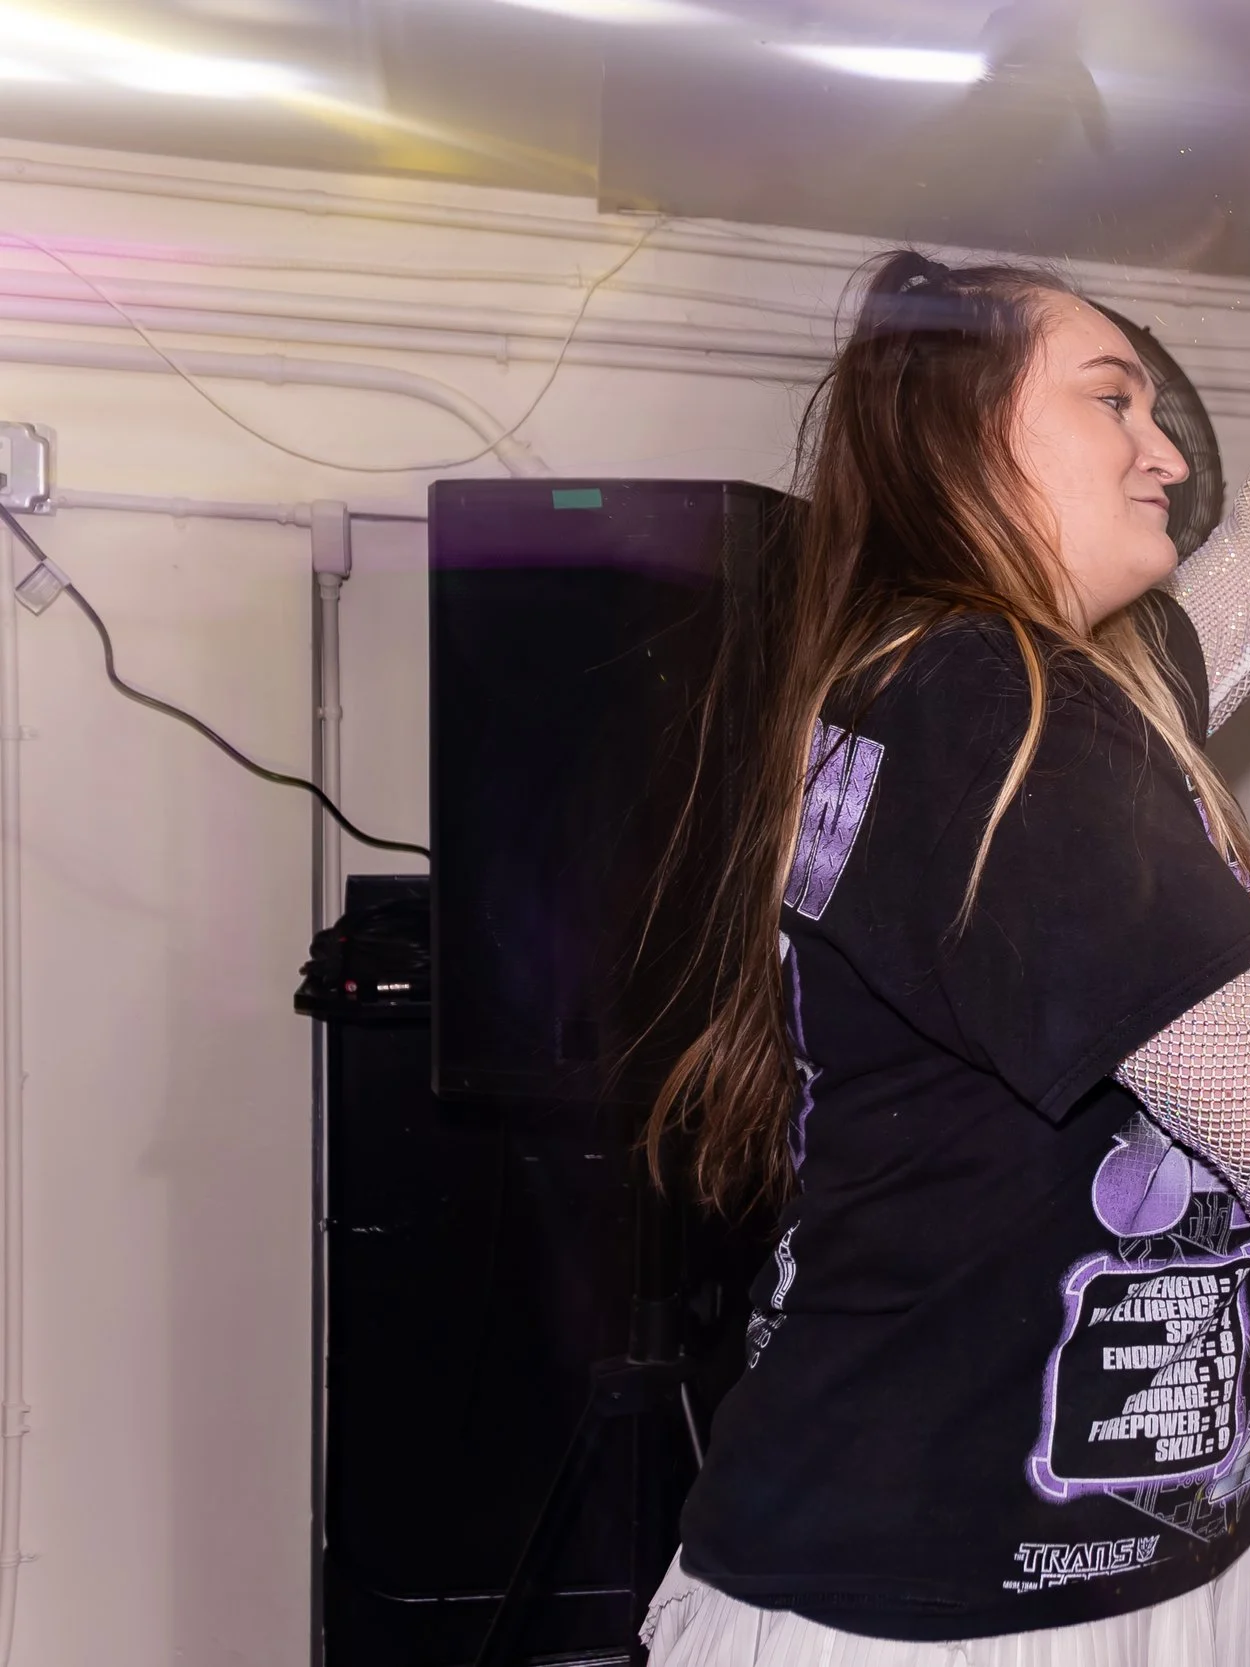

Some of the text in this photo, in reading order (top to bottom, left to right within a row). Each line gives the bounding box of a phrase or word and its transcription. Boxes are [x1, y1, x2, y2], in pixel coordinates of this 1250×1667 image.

[1219, 1331, 1236, 1354] 8
[1213, 1355, 1237, 1380] 10
[1223, 1379, 1234, 1402] 9
[1214, 1403, 1230, 1428] 10
[1218, 1427, 1231, 1450] 9
